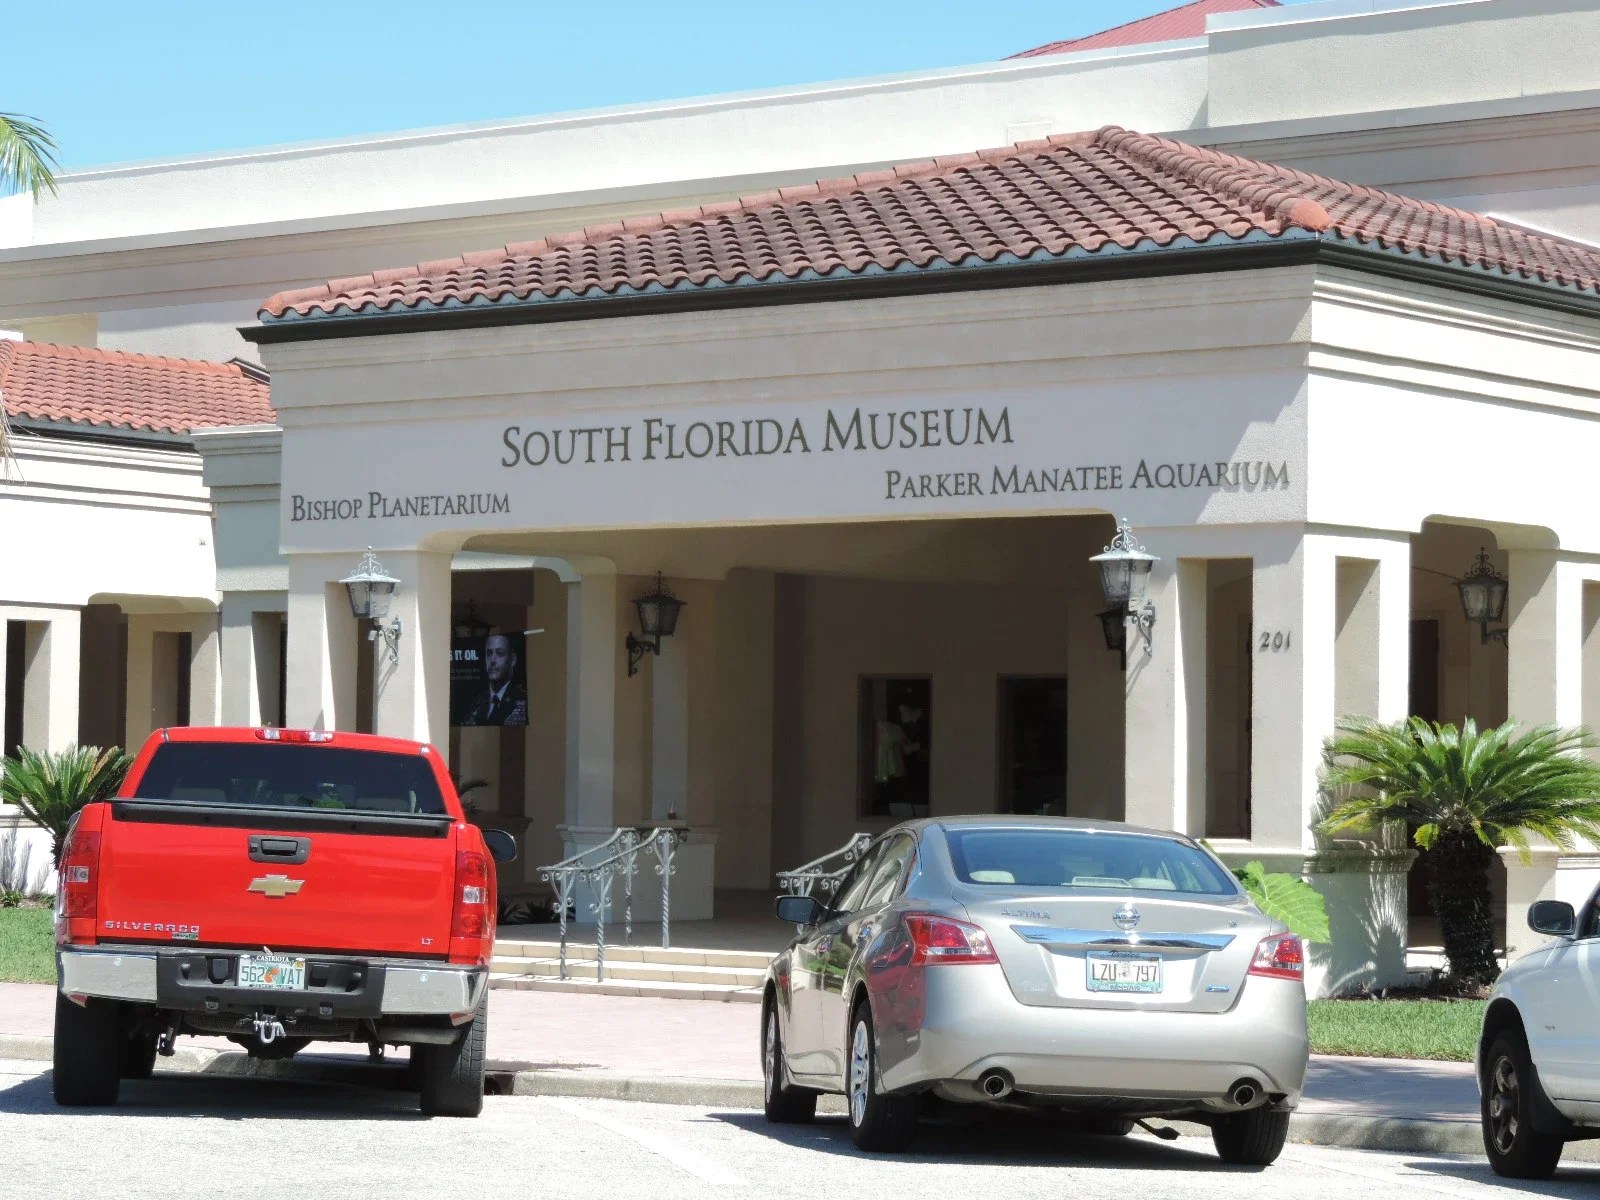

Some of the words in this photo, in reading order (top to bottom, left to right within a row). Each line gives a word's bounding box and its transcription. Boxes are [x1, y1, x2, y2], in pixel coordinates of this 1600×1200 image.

[502, 426, 632, 468] SOUTH
[642, 418, 811, 460] FLORIDA
[822, 407, 1014, 452] MUSEUM
[885, 470, 984, 500] PARKER
[990, 464, 1123, 496] MANATEE
[1130, 459, 1290, 491] AQUARIUM
[291, 495, 362, 522] BISHOP
[368, 491, 510, 519] PLANETARIUM
[1260, 630, 1291, 649] 201
[105, 920, 200, 933] SILVERADO
[421, 937, 434, 945] LT
[241, 966, 265, 983] 562
[280, 967, 303, 985] VAT
[1092, 963, 1118, 981] LZU
[1133, 964, 1157, 982] 797
